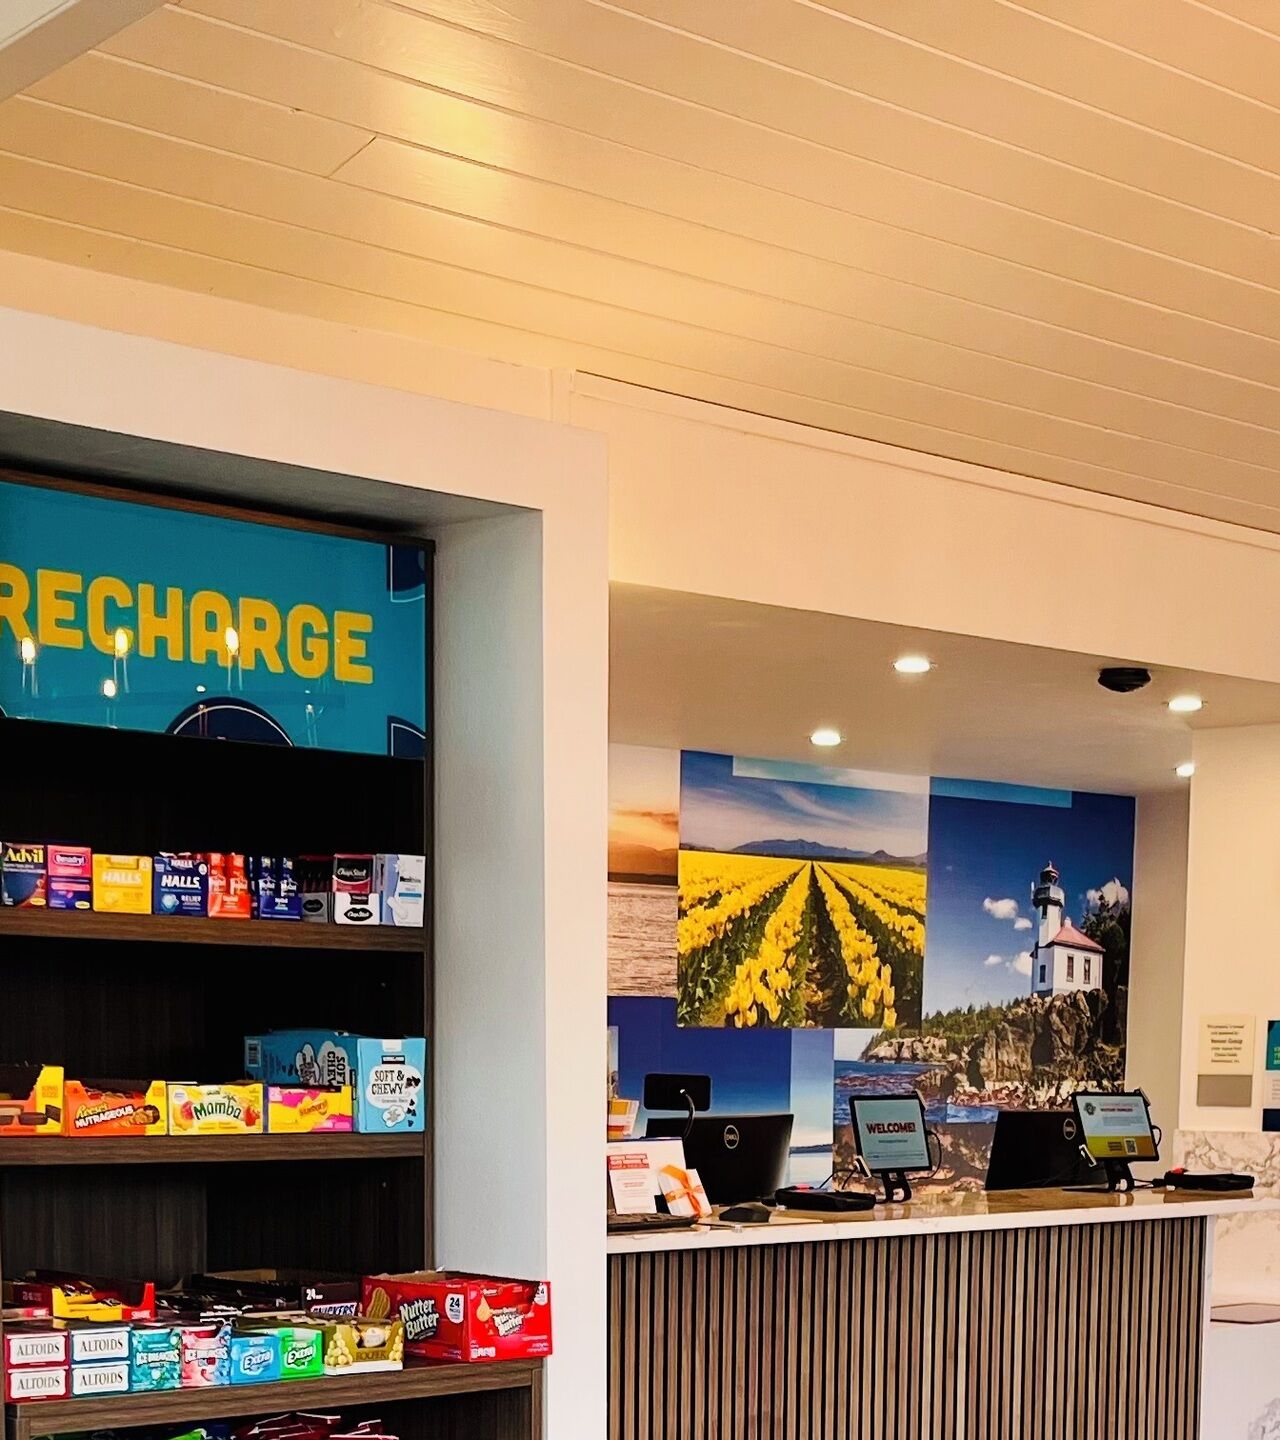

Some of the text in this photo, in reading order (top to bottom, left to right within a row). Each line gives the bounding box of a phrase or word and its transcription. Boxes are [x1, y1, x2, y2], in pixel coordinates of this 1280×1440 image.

[4, 847, 44, 863] Advil
[161, 875, 201, 888] HALLS
[374, 1070, 404, 1082] SOFT &
[371, 1083, 404, 1095] CHEWY
[75, 1104, 134, 1129] NUTRAGEOUS
[193, 1099, 242, 1120] Mamba
[866, 1122, 917, 1134] WELCOME!
[306, 1288, 316, 1301] 24
[449, 1296, 461, 1308] 24
[399, 1299, 435, 1322] Nutter
[405, 1312, 440, 1340] Butter
[17, 1342, 60, 1357] ALTOIDS
[80, 1337, 124, 1352] ALTOIDS
[17, 1376, 61, 1391] ALTOIDS
[80, 1370, 124, 1386] ALTOIDS
